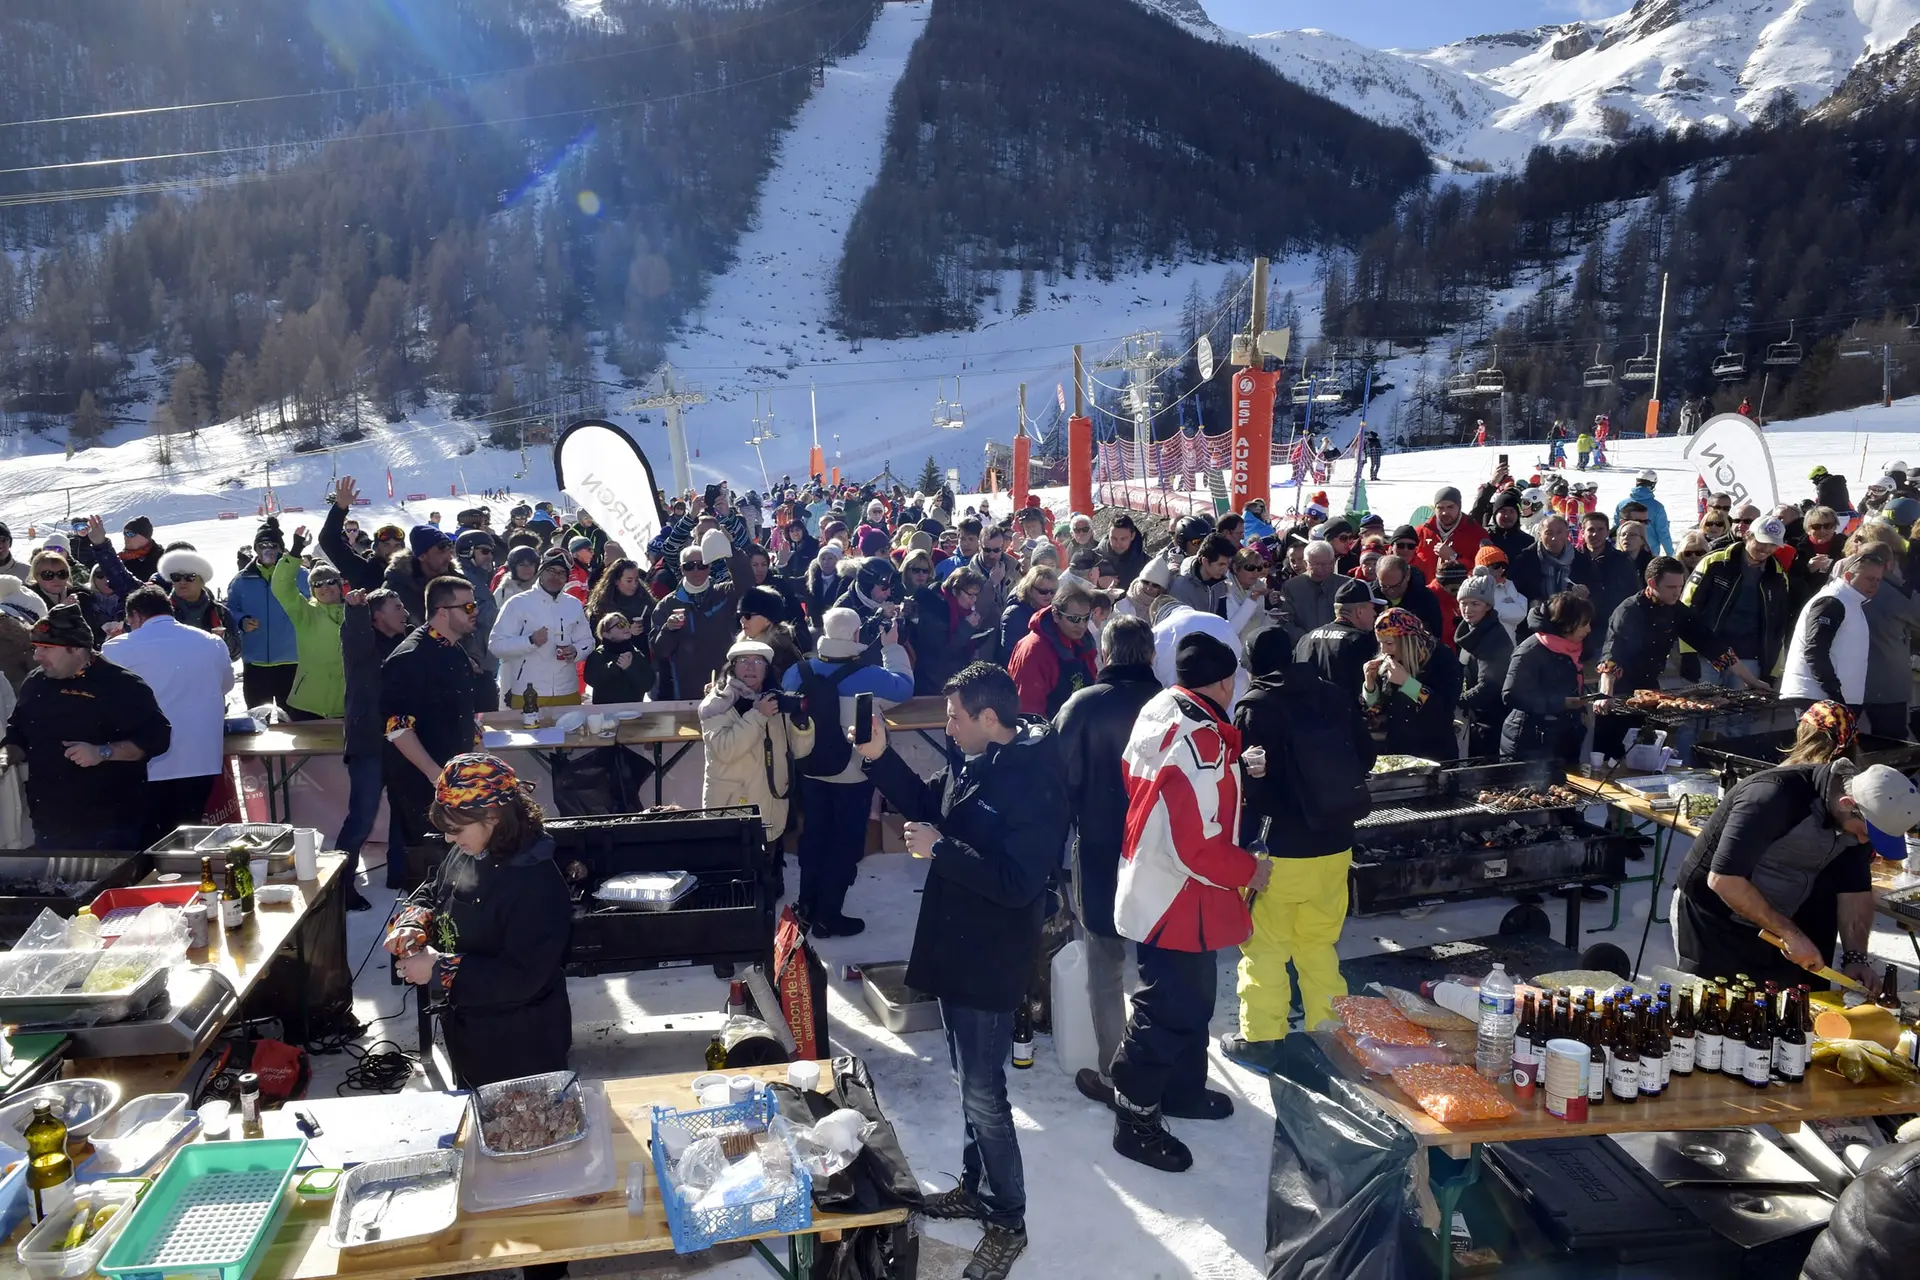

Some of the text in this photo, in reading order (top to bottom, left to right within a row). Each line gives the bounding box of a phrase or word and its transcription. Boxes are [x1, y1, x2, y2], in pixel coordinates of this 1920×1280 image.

[1234, 400, 1251, 494] ESF AURON
[1310, 629, 1347, 640] FAURE
[785, 981, 798, 998] de
[802, 1011, 815, 1041] qualité
